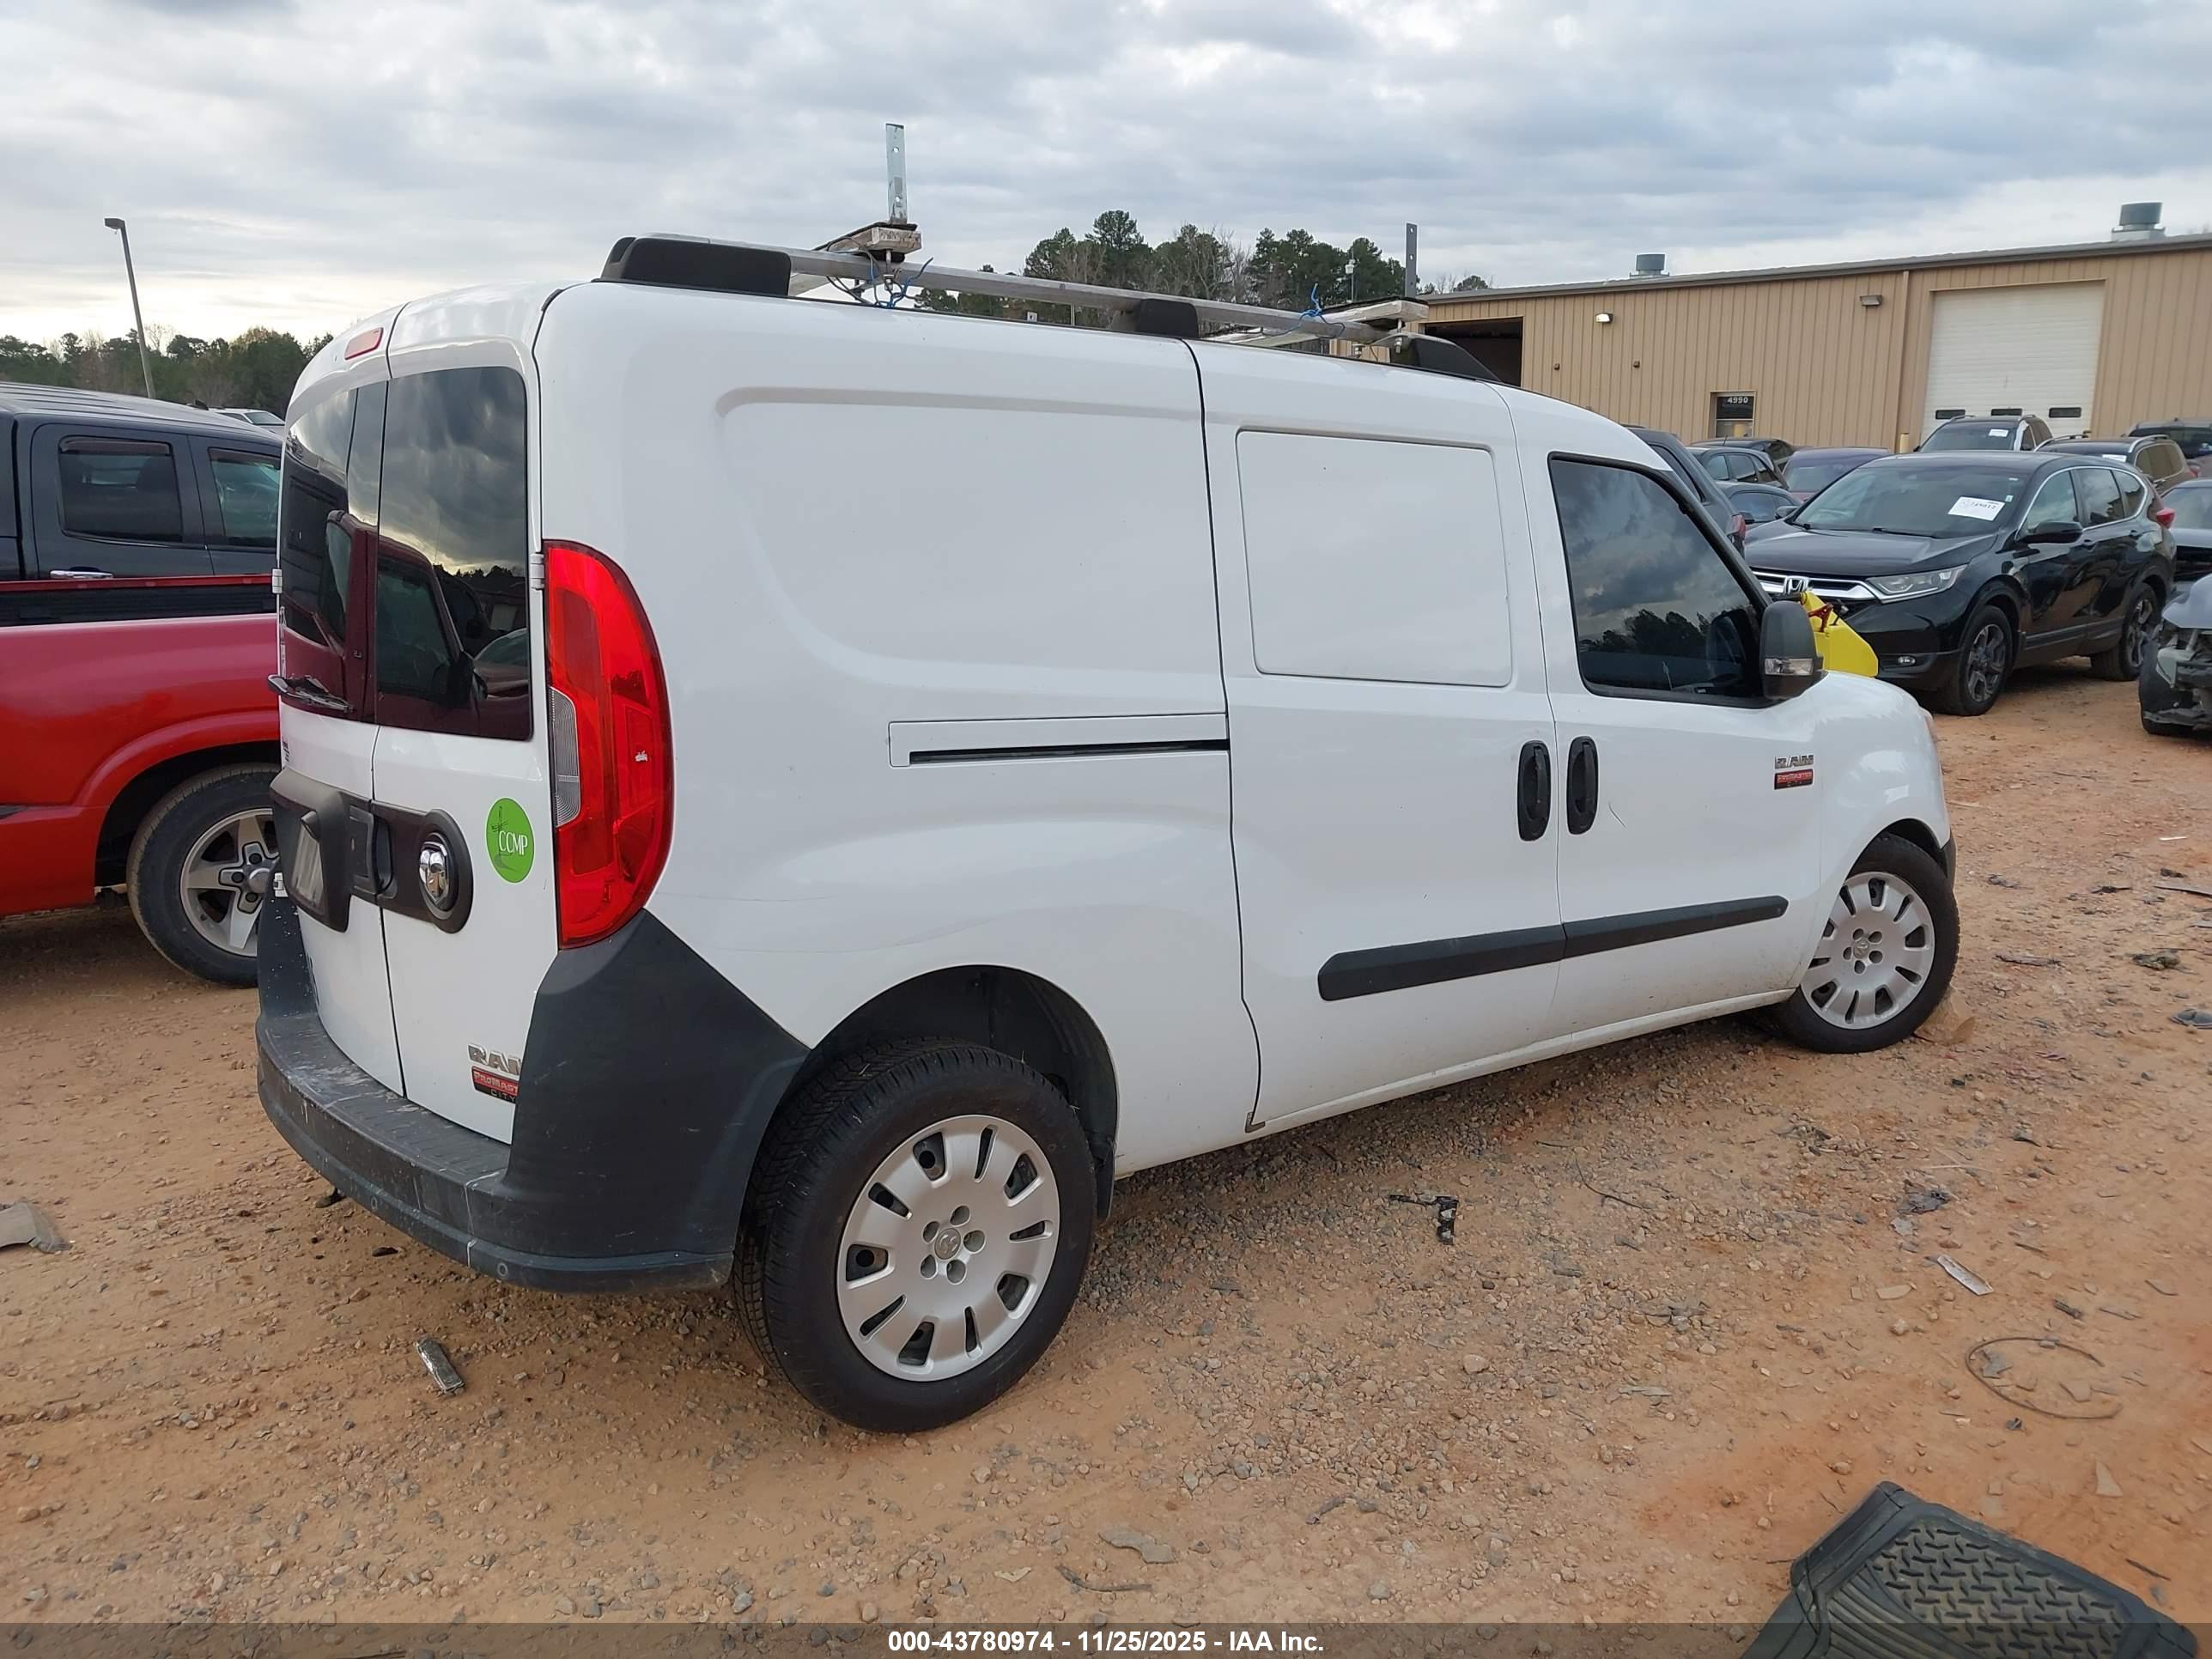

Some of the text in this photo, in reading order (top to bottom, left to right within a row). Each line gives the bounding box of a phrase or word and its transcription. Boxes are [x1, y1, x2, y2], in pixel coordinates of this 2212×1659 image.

[1774, 754, 1814, 769] RAM
[499, 830, 528, 856] CCMP
[490, 1089, 516, 1103] CITY
